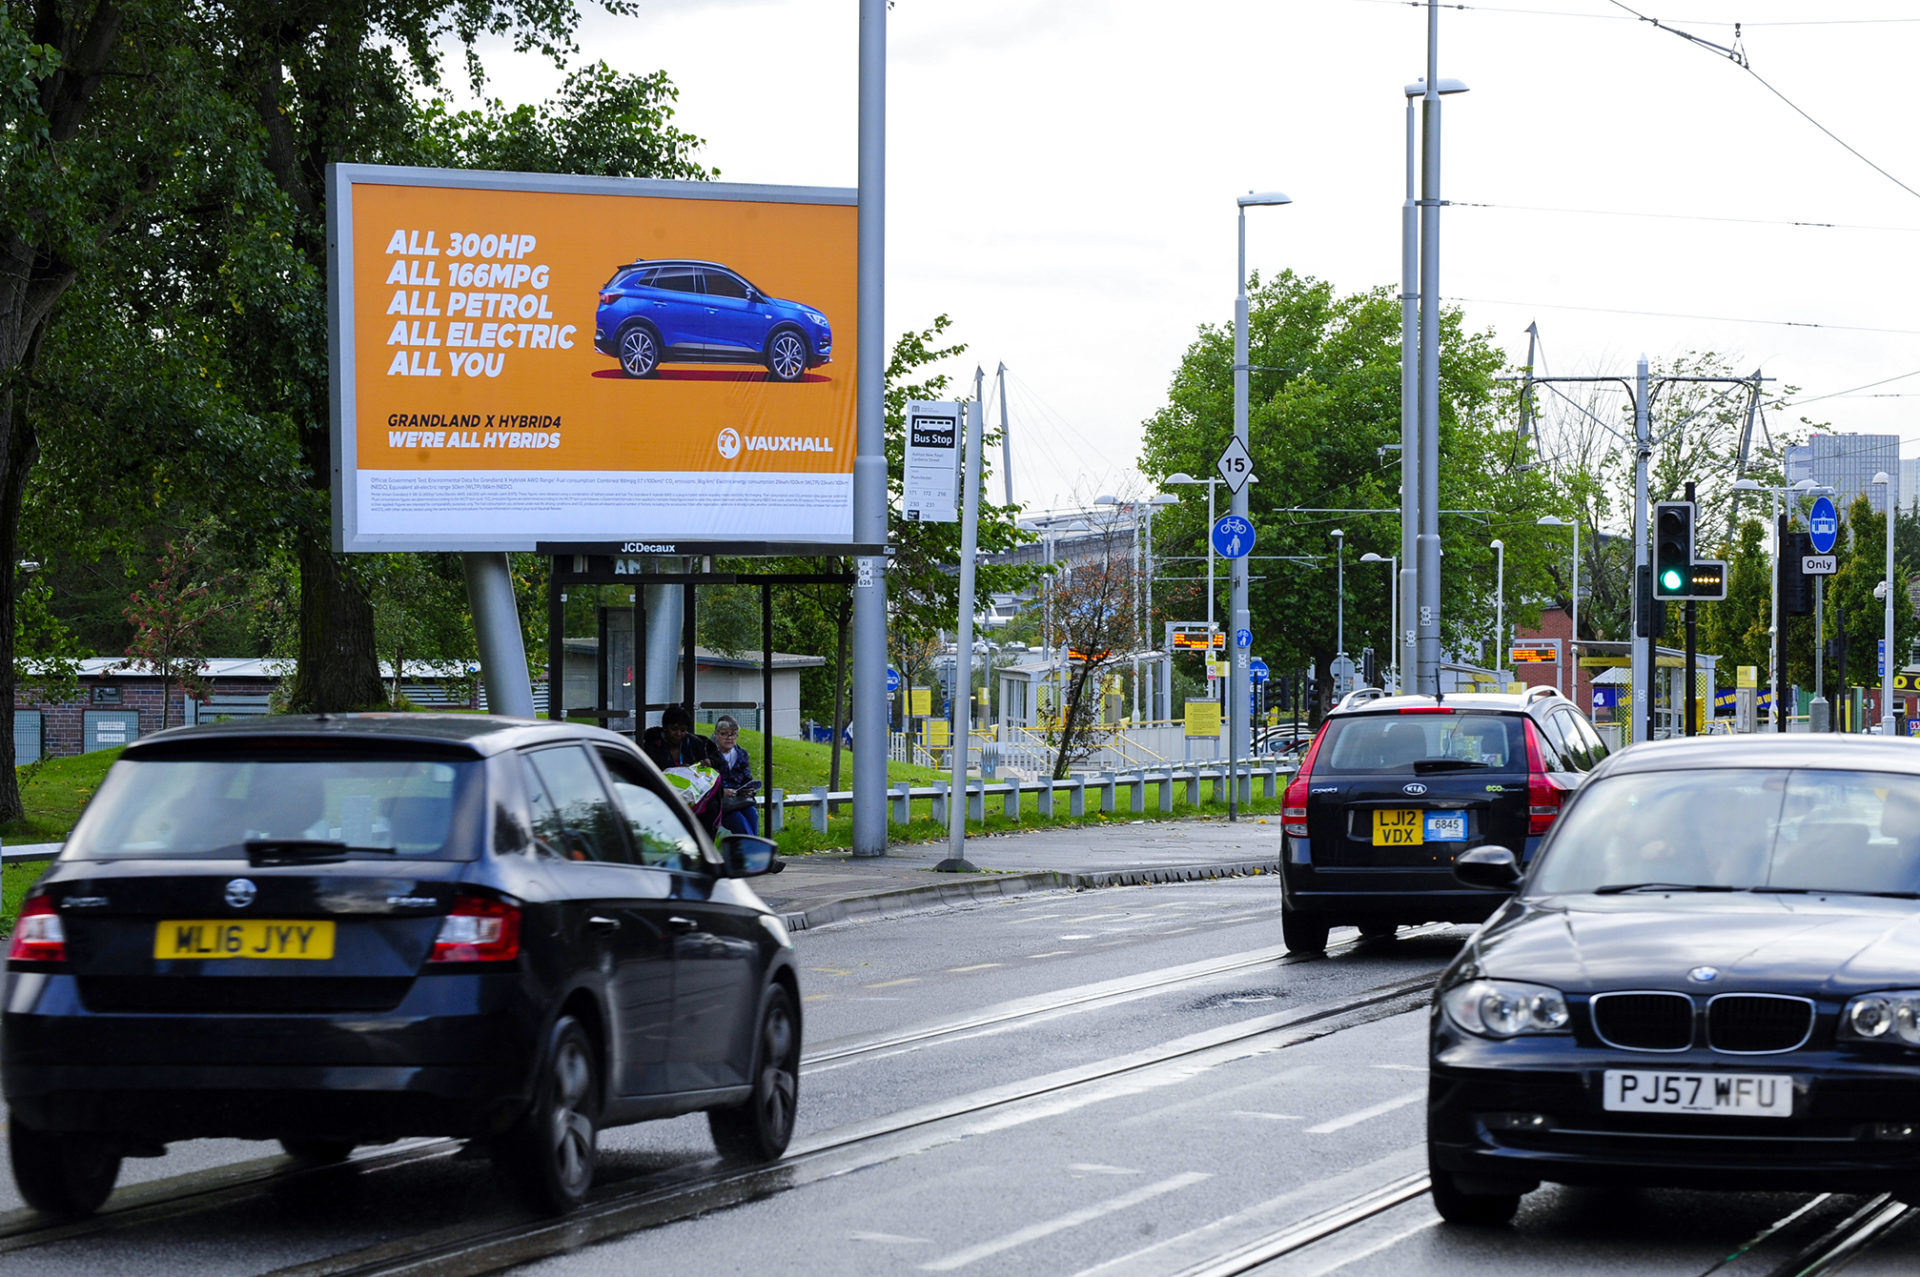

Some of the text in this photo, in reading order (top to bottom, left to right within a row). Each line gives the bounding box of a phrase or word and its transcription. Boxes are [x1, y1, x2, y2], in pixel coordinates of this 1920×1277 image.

[385, 229, 537, 259] ALL 300HP
[385, 260, 549, 289] ALL 166MPG
[386, 290, 553, 319] ALL PETROL
[386, 320, 577, 349] ALL ELECTRIC
[387, 350, 505, 377] ALL YOU
[388, 413, 561, 428] GRANDLAND X HYBRID4
[388, 431, 561, 449] WE'RE ALL HYBRIDS
[744, 435, 834, 452] VAUXHALL
[914, 433, 952, 446] Bus Stop
[1225, 457, 1245, 472] 15
[621, 542, 676, 553] JCDecaux
[1806, 560, 1832, 570] Only
[1593, 692, 1605, 705] 4
[1406, 785, 1424, 793] KIA
[1379, 811, 1416, 826] LJ12
[1434, 819, 1459, 829] 6845
[1382, 829, 1414, 843] VDX
[253, 926, 315, 954] JYY
[1620, 1075, 1776, 1107] PJ57 WFU
